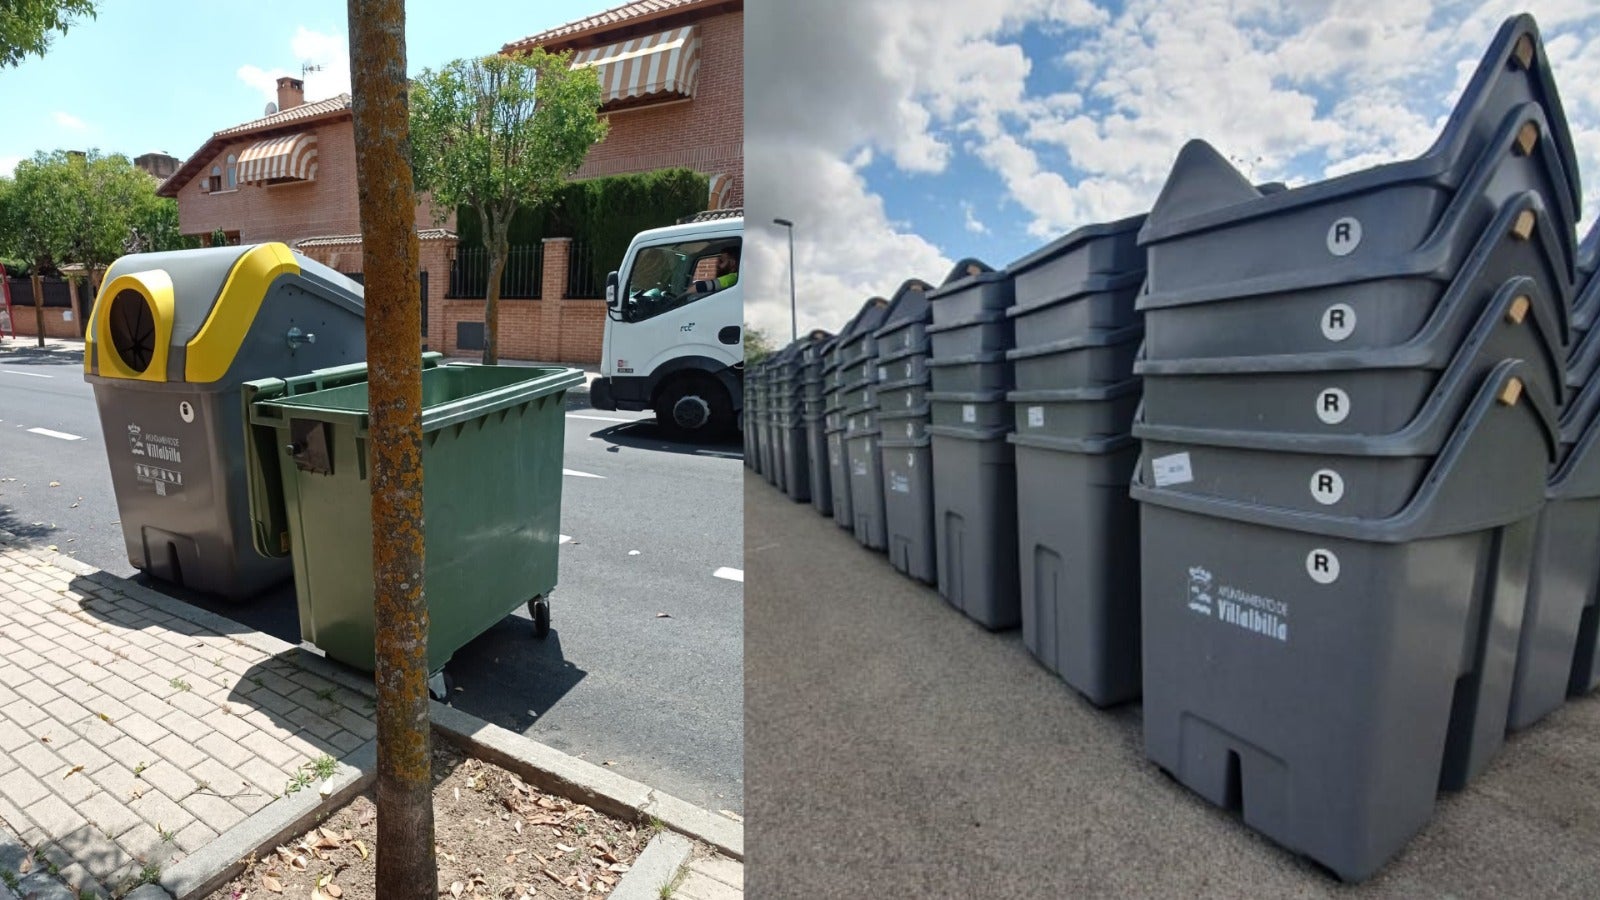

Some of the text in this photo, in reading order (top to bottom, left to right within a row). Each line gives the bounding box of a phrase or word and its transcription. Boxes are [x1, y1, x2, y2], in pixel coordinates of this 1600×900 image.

[1335, 223, 1351, 244] R
[1329, 310, 1345, 329] R
[1323, 393, 1339, 412] R
[146, 443, 181, 463] Villalbilla
[1318, 474, 1333, 493] R
[1314, 554, 1329, 573] R
[1218, 599, 1287, 641] Villalbilla
